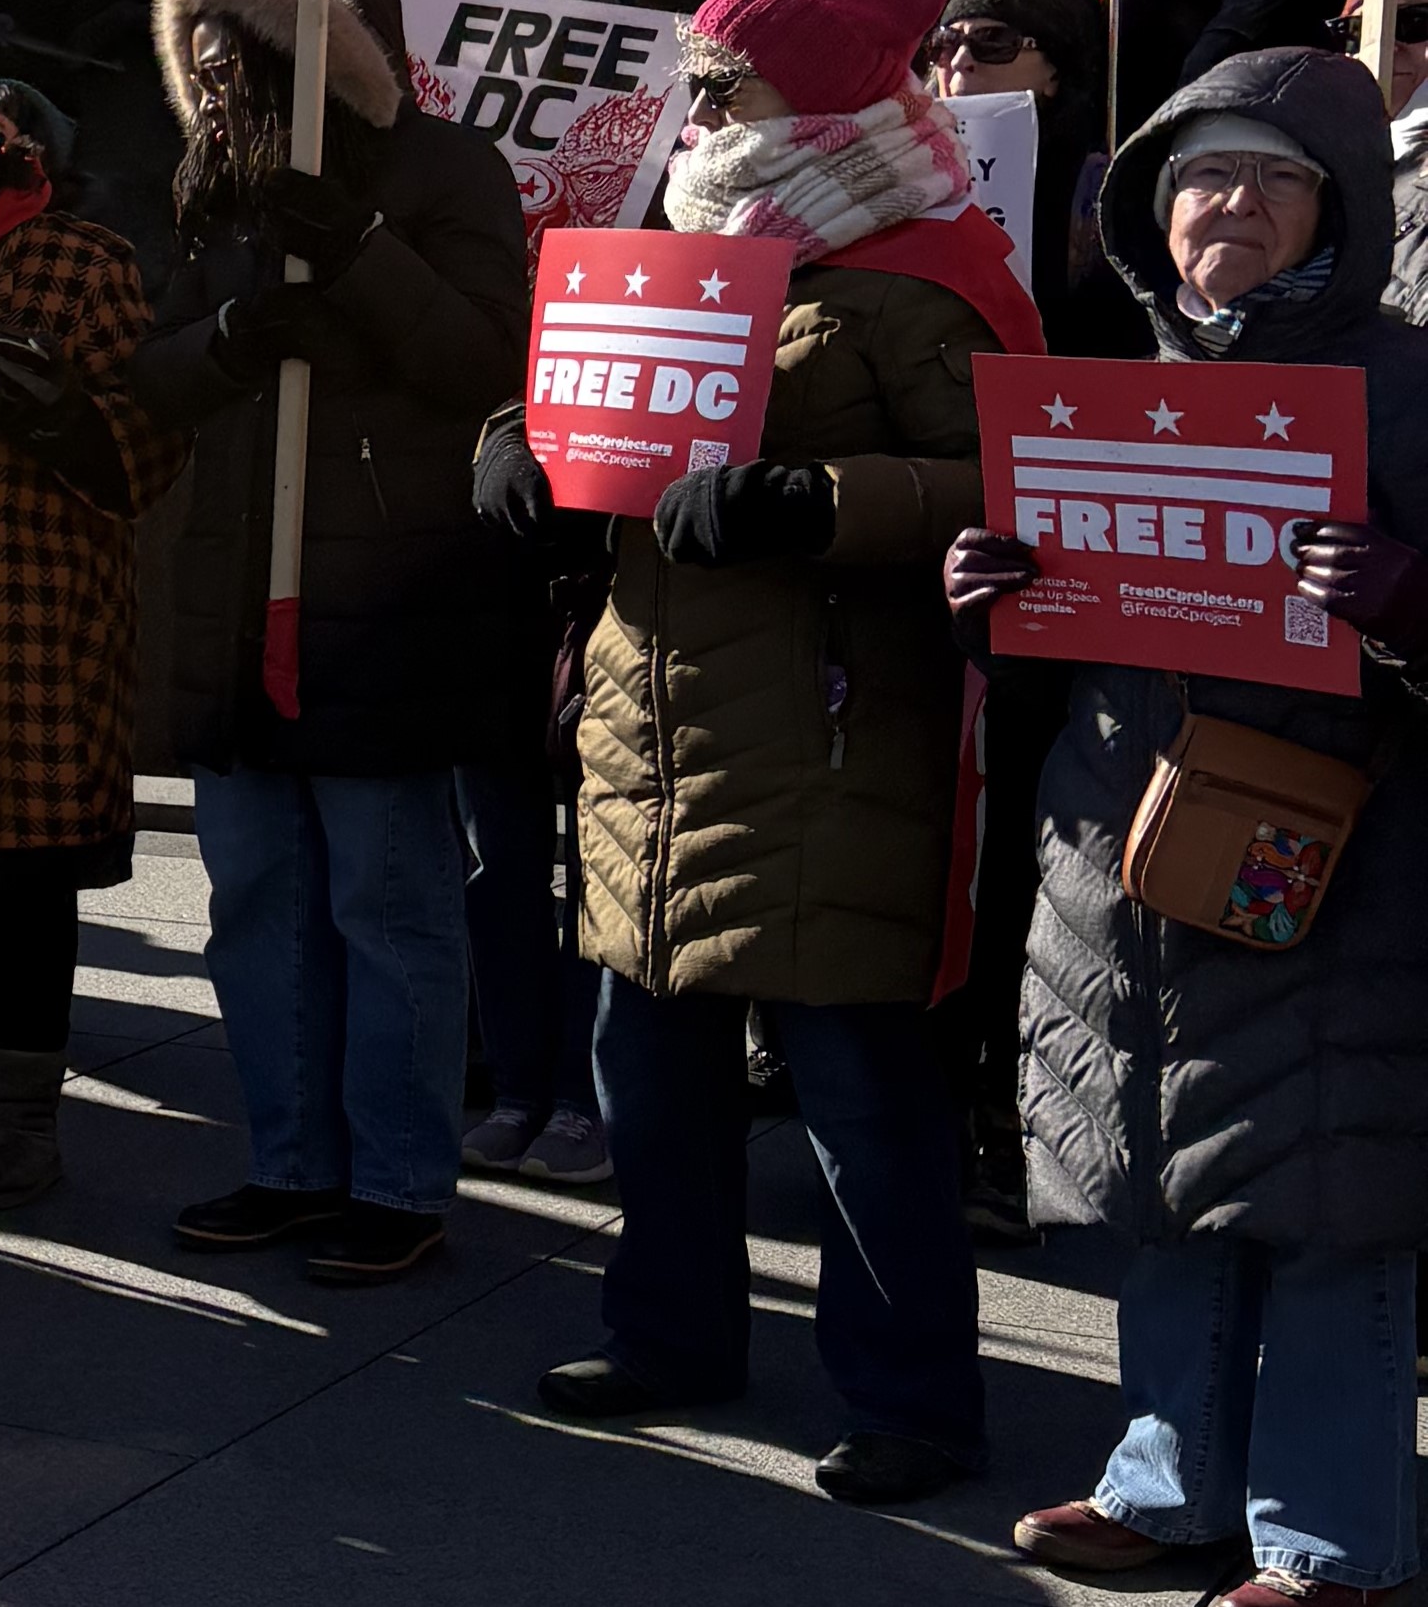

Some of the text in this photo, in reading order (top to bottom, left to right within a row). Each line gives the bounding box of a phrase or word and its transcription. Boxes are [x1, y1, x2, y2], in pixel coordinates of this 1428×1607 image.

[435, 3, 659, 93] FREE
[459, 75, 577, 151] DC
[533, 358, 740, 421] FREE DC
[1014, 496, 1206, 561] FREE
[1019, 601, 1077, 614] Organize.
[1046, 590, 1061, 602] Up
[1119, 583, 1264, 613] FreeDCproject.org
[1120, 602, 1242, 626] @FreeDCproject
